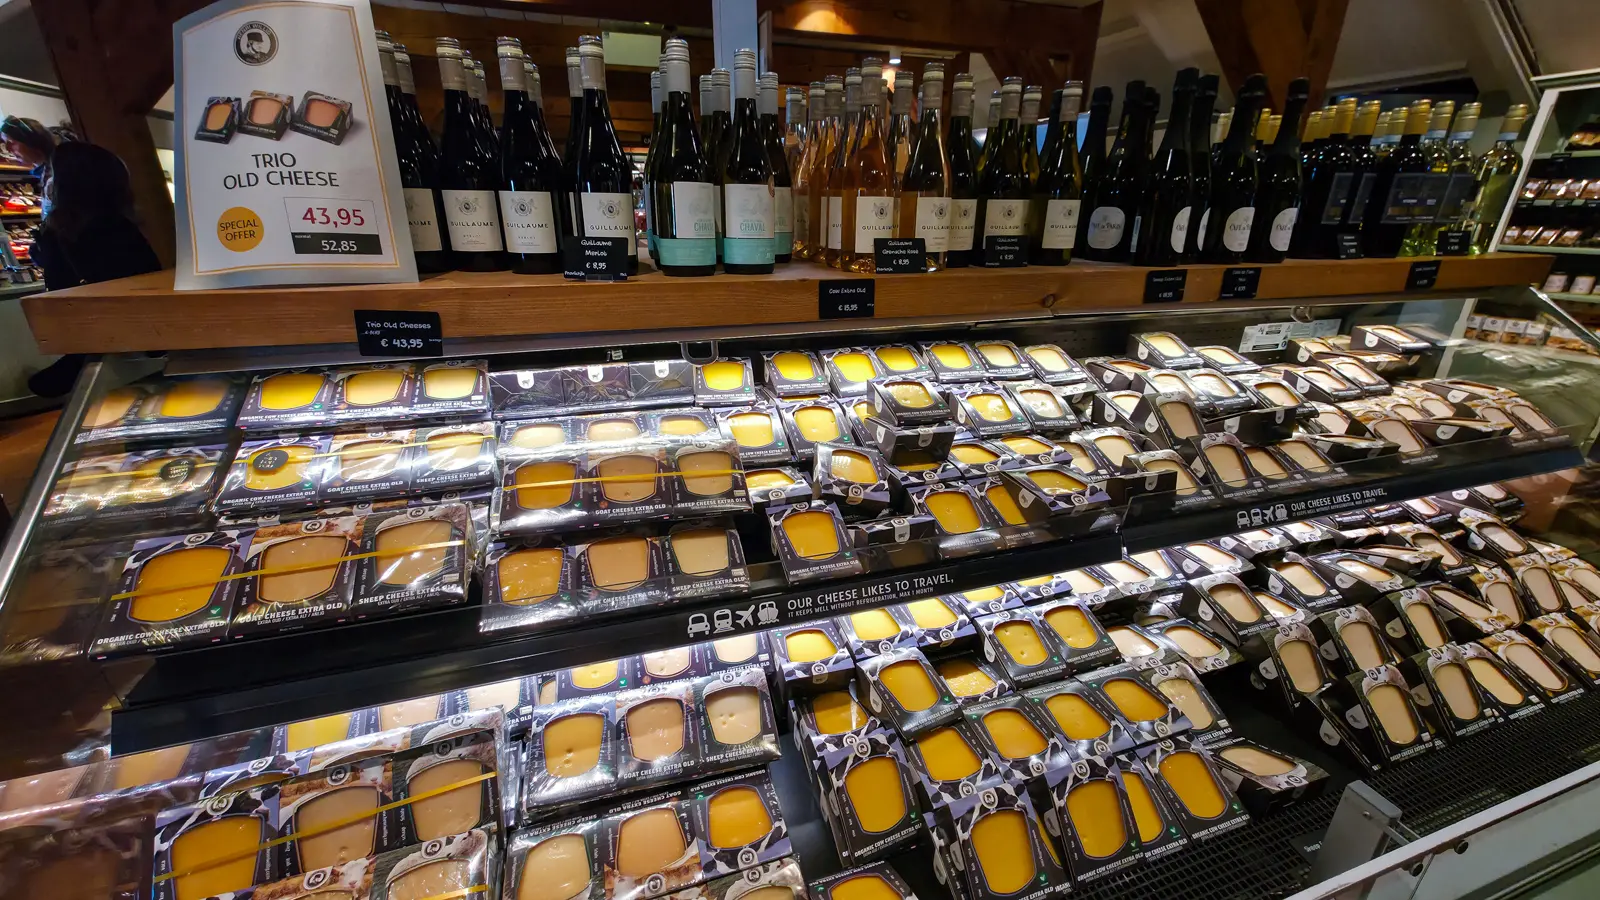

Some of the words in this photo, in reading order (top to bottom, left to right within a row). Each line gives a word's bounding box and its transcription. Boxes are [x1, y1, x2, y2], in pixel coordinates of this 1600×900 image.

[252, 153, 296, 168] TRIO
[223, 172, 259, 190] OLD
[266, 171, 339, 187] CHEESE
[302, 207, 365, 228] 43,95
[220, 219, 259, 232] SPECIAL
[225, 229, 256, 242] OFFER
[321, 240, 357, 252] 52,85
[592, 262, 607, 270] 8,95
[380, 338, 389, 347] €
[392, 339, 424, 349] 43,95
[1291, 502, 1306, 512] OUR
[1307, 497, 1331, 508] CHEESE
[1332, 494, 1351, 505] LIKES
[1351, 491, 1361, 500] TO
[789, 567, 809, 575] ORGANIC
[672, 584, 691, 592] SHEEP
[787, 597, 813, 611] OUR
[817, 589, 858, 605] CHEESE
[862, 583, 891, 598] LIKES
[895, 580, 910, 591] TO
[913, 573, 954, 586] TRAVEL,
[358, 596, 384, 605] SHEEP
[386, 591, 416, 600] CHEESE
[417, 587, 440, 596] EXTRA
[795, 609, 813, 617] KEEPS
[814, 606, 829, 614] WELL
[830, 601, 855, 612] WITHOUT
[856, 593, 899, 606] REFRIGERATION,
[915, 587, 934, 595] MONTH
[265, 609, 295, 620] CHEESE
[298, 606, 324, 615] EXTRA
[326, 602, 343, 610] OLD
[97, 634, 133, 645] ORGANIC
[134, 631, 152, 639] COW
[520, 714, 532, 722] OLD
[706, 754, 725, 763] SHEEP
[725, 750, 747, 759] CHEESE
[682, 760, 695, 768] OLD
[623, 801, 642, 810] EXTRA
[643, 795, 665, 803] CHEESE
[530, 826, 551, 837] EXTRA
[552, 820, 576, 830] CHEESE
[1192, 829, 1209, 840] ORGANIC
[1209, 826, 1218, 834] COW
[1218, 822, 1231, 831] CHEESE
[1230, 817, 1242, 826] EXTRA
[1242, 814, 1251, 822] OLD
[854, 846, 873, 858] ORGANIC
[874, 842, 884, 850] COW
[884, 836, 900, 846] CHEESE
[900, 829, 915, 839] EXTRA
[1151, 845, 1166, 856] CHEESE
[1166, 841, 1180, 850] EXTRA
[1179, 838, 1188, 846] OLD
[1077, 871, 1095, 882] ORGANIC
[1096, 867, 1107, 875] COW
[1107, 861, 1121, 871] CHEESE
[1121, 856, 1136, 866] EXTRA
[1136, 852, 1144, 860] OLD
[1029, 890, 1044, 900] EXTRA
[1044, 886, 1054, 895] OLD
